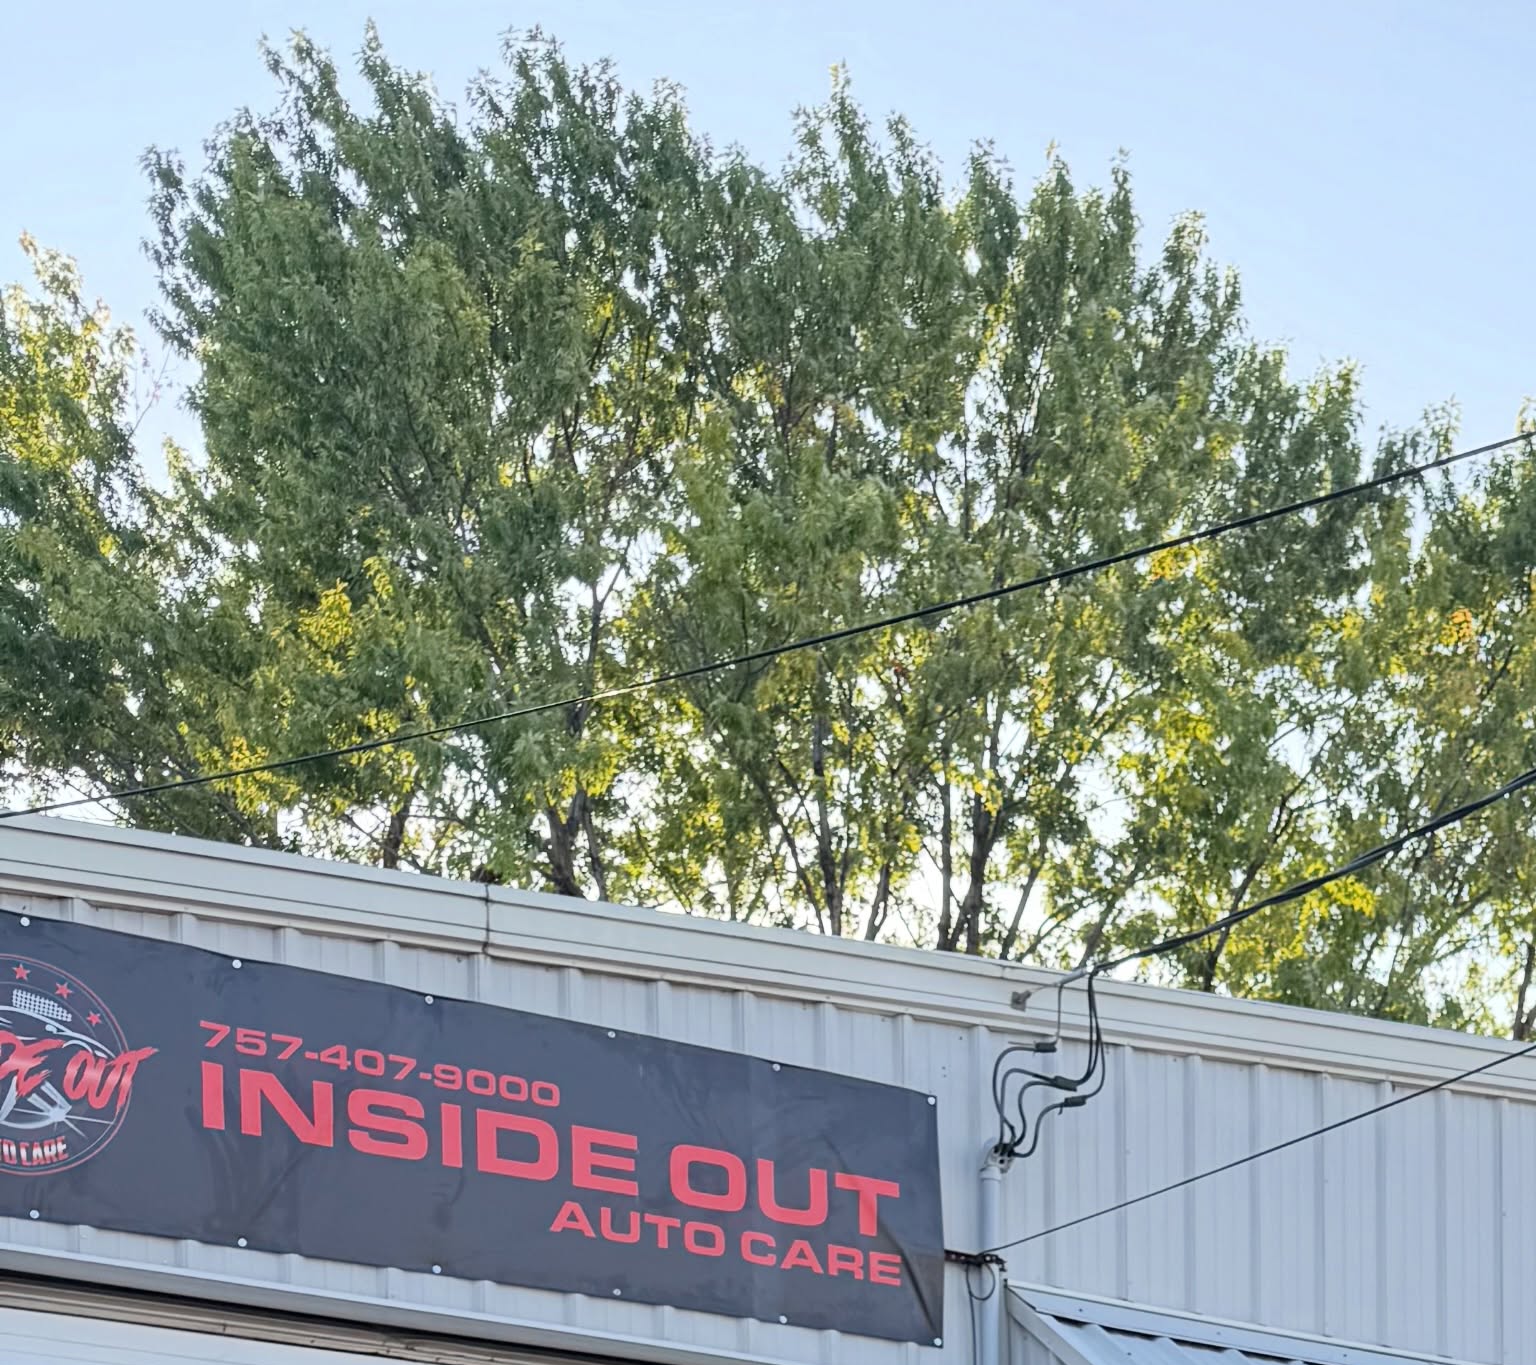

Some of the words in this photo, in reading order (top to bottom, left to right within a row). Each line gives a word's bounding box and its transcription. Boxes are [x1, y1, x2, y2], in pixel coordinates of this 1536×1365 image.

[63, 1046, 158, 1114] OUT
[200, 1019, 561, 1107] 757-407-9000
[19, 1135, 69, 1167] CARE
[201, 1060, 639, 1197] INSIDE
[669, 1143, 900, 1237] OUT
[550, 1200, 726, 1257] AUTO
[740, 1230, 902, 1287] CARE
